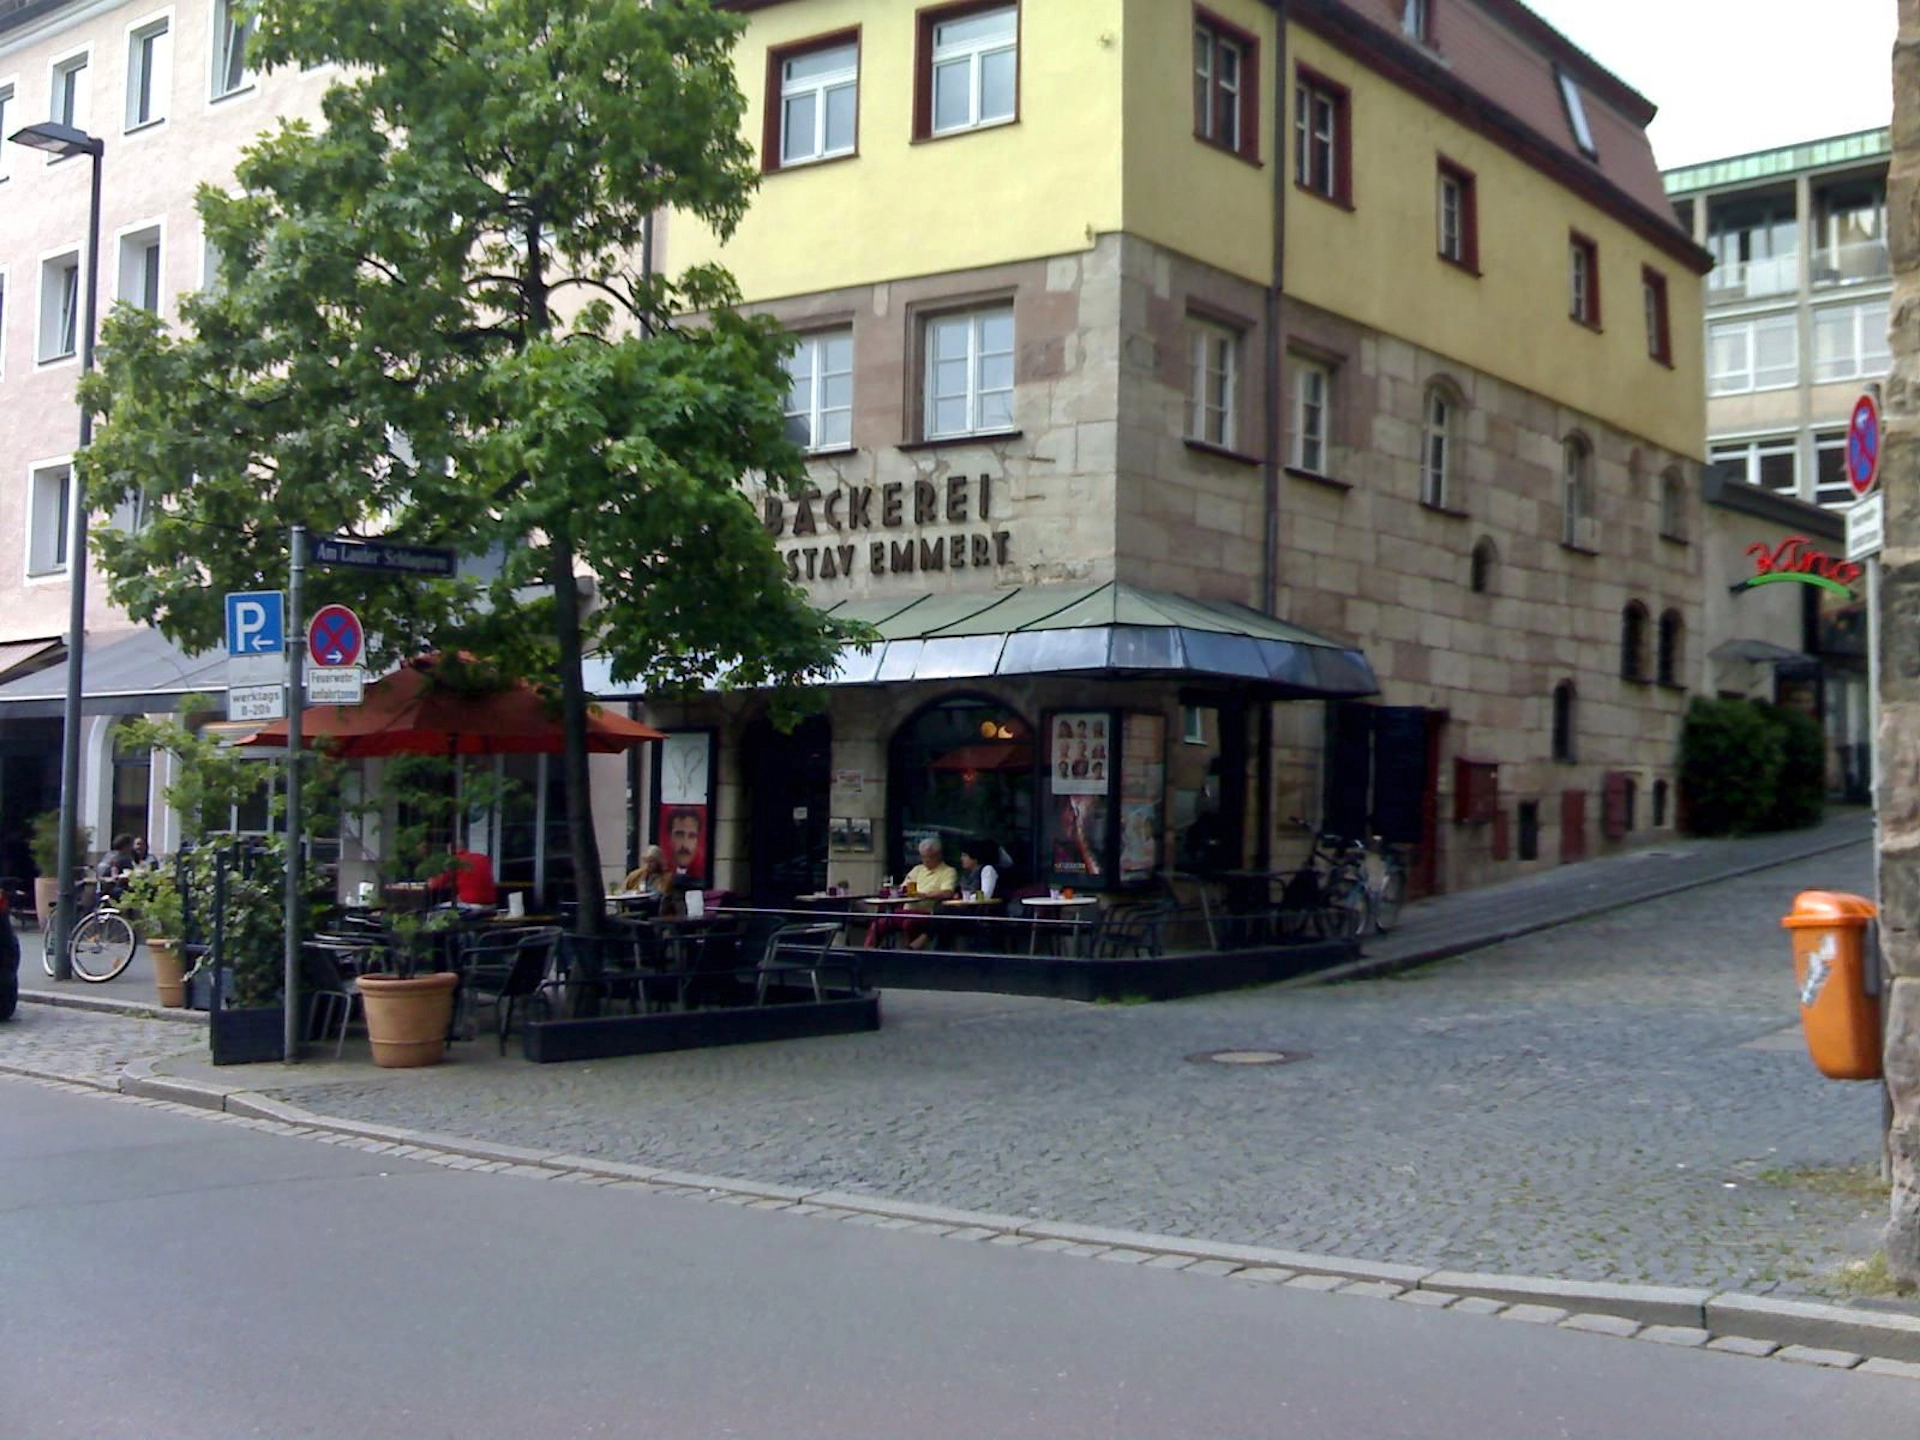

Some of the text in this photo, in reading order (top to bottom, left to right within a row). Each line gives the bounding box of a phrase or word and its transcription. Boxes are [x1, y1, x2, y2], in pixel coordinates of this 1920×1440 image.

[764, 474, 990, 538] BÄCKEREI
[317, 543, 338, 561] Am
[780, 531, 1010, 582] STAV EMMERT
[236, 602, 266, 652] P
[232, 691, 279, 703] werktags
